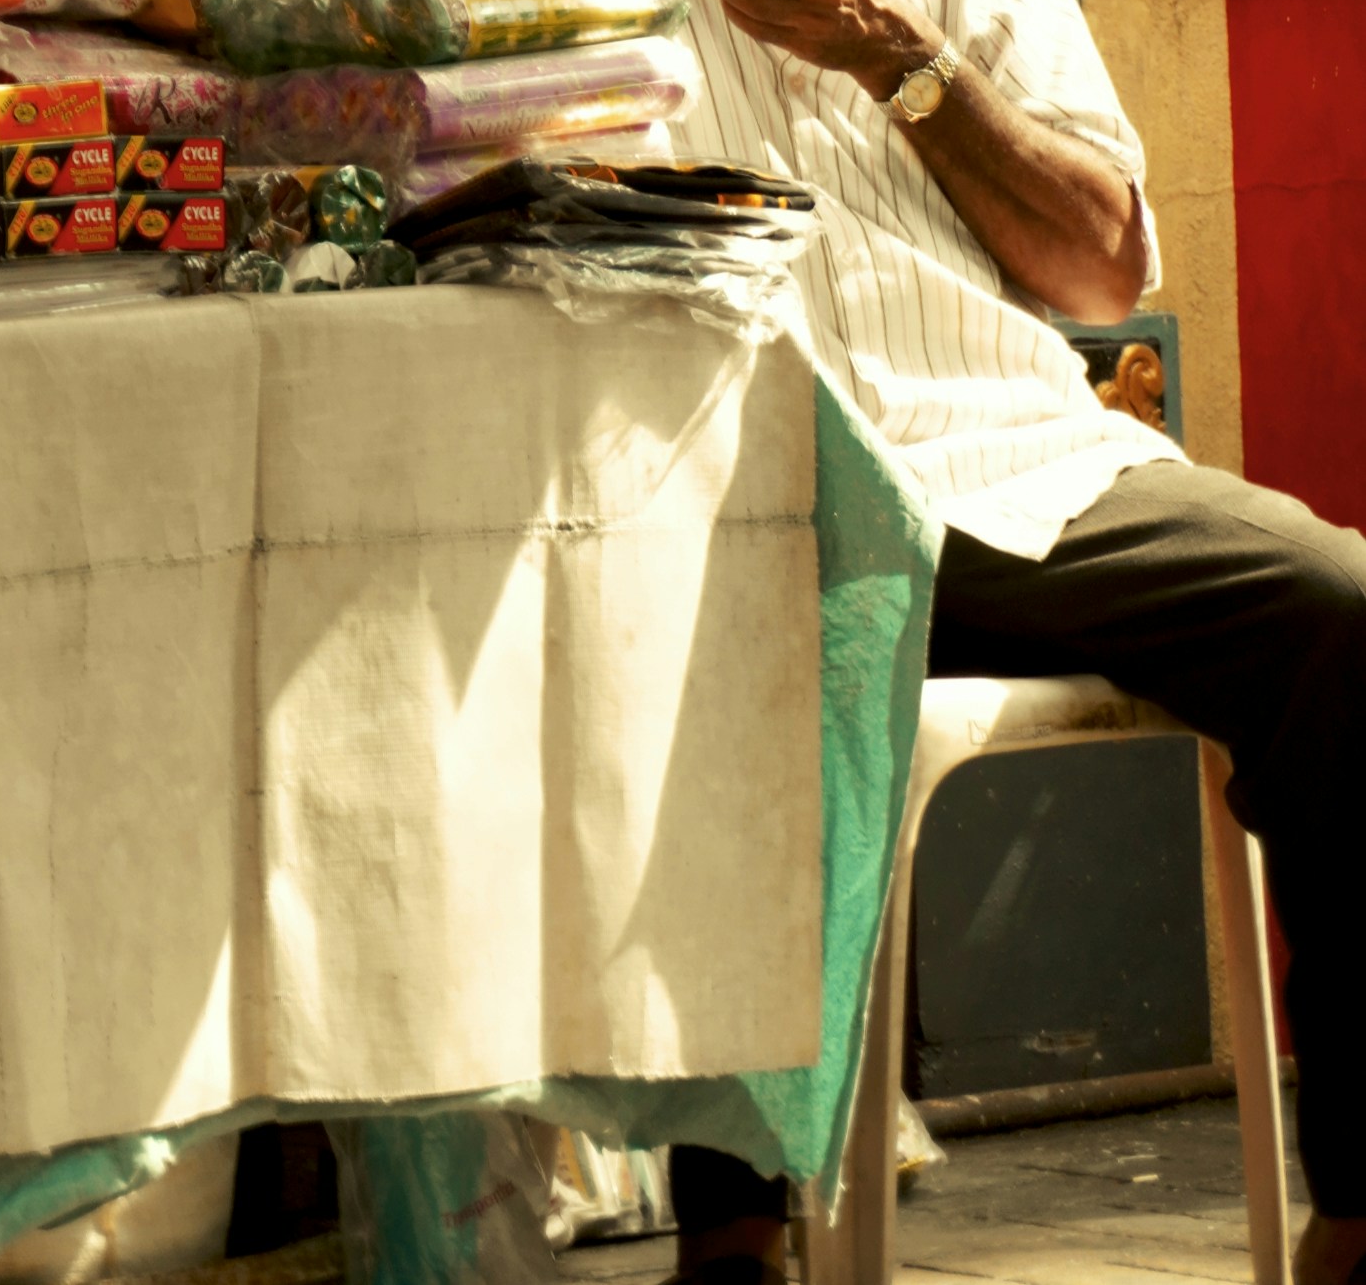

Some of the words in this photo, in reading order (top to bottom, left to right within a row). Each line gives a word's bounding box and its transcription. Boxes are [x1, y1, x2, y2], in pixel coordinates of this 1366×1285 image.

[41, 94, 78, 120] three
[61, 109, 73, 123] in
[75, 95, 100, 115] one
[71, 147, 110, 165] CYCLE
[182, 146, 219, 161] CYCLE
[74, 206, 112, 224] CYCLE
[184, 205, 221, 221] CYCLE
